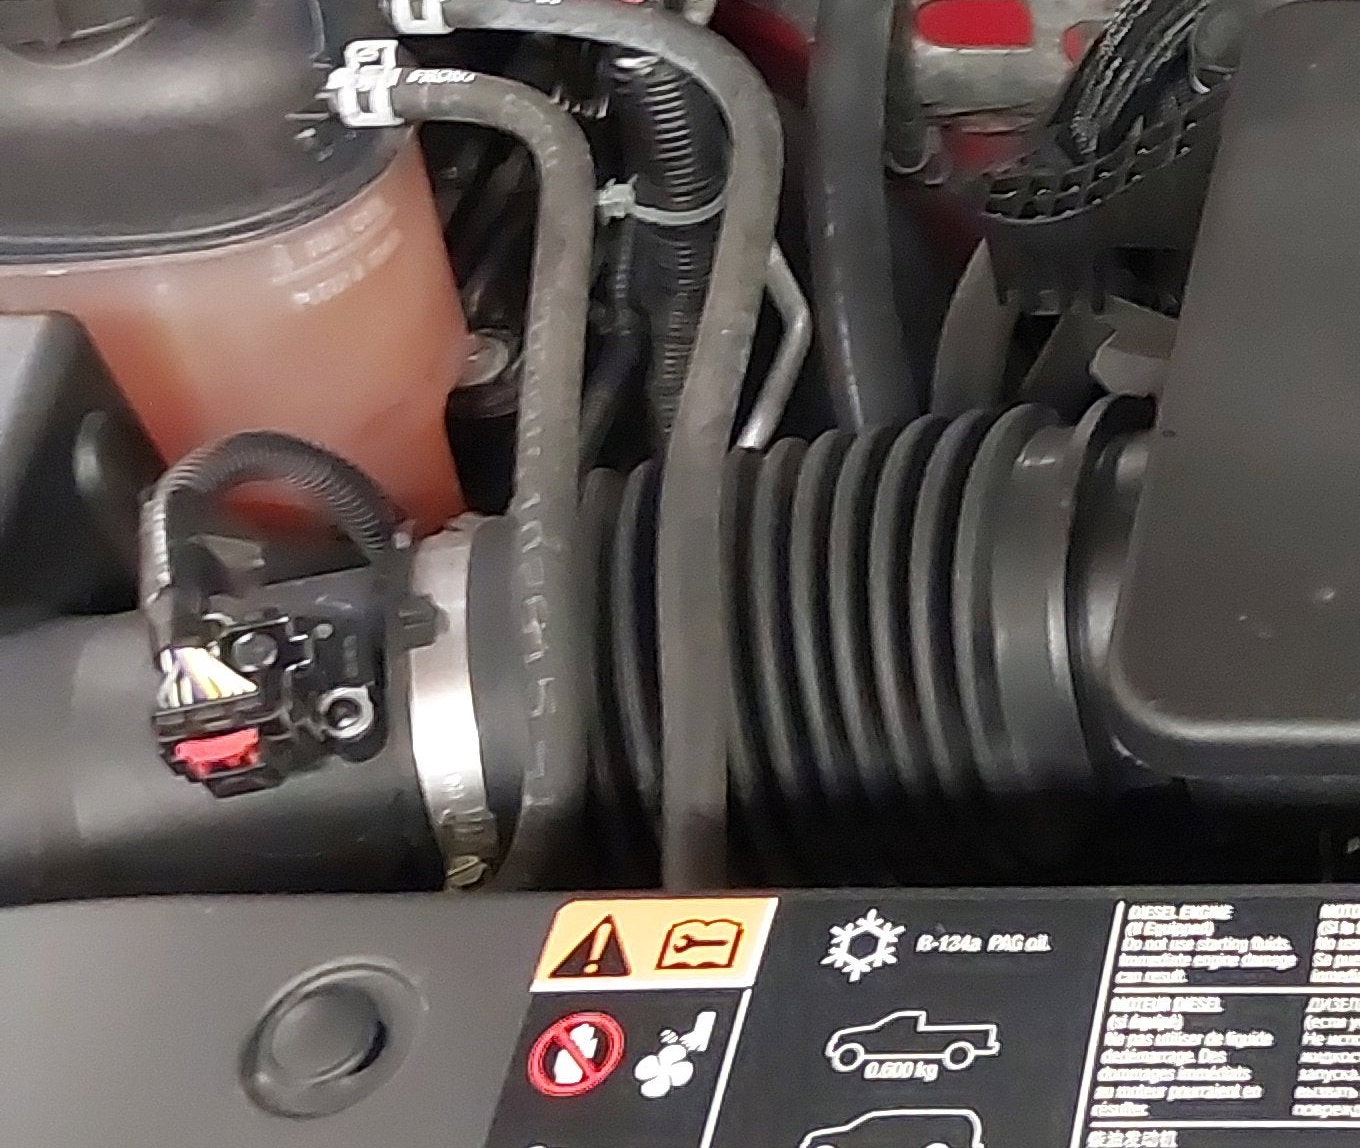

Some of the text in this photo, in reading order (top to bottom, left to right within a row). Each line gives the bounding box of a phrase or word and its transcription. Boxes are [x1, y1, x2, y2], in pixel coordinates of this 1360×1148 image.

[406, 69, 475, 84] FRONT
[1128, 904, 1234, 920] DIESEL ENGINE
[1144, 921, 1215, 937] Equipped)
[987, 933, 1024, 951] PAG
[1121, 938, 1142, 951] Do
[1143, 938, 1168, 951] not
[1169, 939, 1195, 951] use
[1195, 937, 1249, 953] starting
[1314, 937, 1336, 950] No
[1118, 953, 1298, 971] Immediate engine damage
[1312, 953, 1332, 967] Se
[1115, 971, 1142, 983] can
[1109, 996, 1225, 1012] MOTEUR DIESEL
[1104, 1030, 1275, 1048] Ne pas utiliser de liquide
[1302, 1032, 1325, 1046] Не
[1198, 1048, 1227, 1064] Des
[864, 1062, 939, 1082] 0.600 kg
[1097, 1066, 1175, 1084] dommages
[1094, 1083, 1264, 1101] au moteur pourraient en
